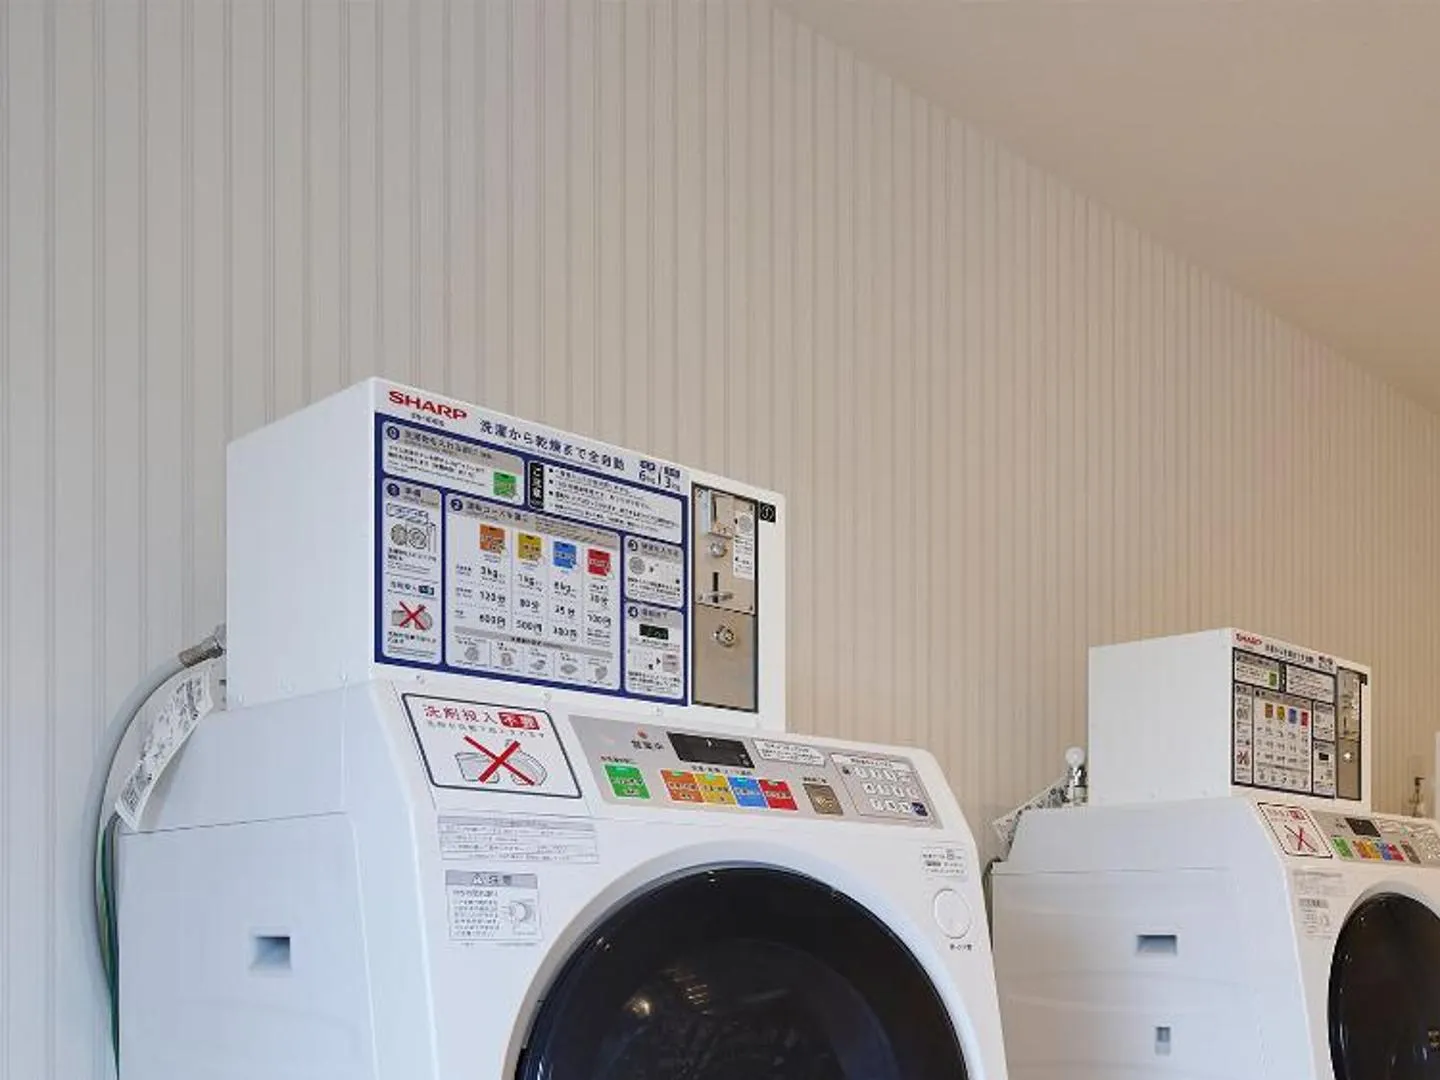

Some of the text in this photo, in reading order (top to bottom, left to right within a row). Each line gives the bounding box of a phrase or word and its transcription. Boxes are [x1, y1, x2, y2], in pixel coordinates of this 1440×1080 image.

[389, 391, 467, 420] SHARP
[480, 418, 625, 471] 洗濯から乾燥まで全自動
[423, 704, 539, 729] 洗剤投入 不要
